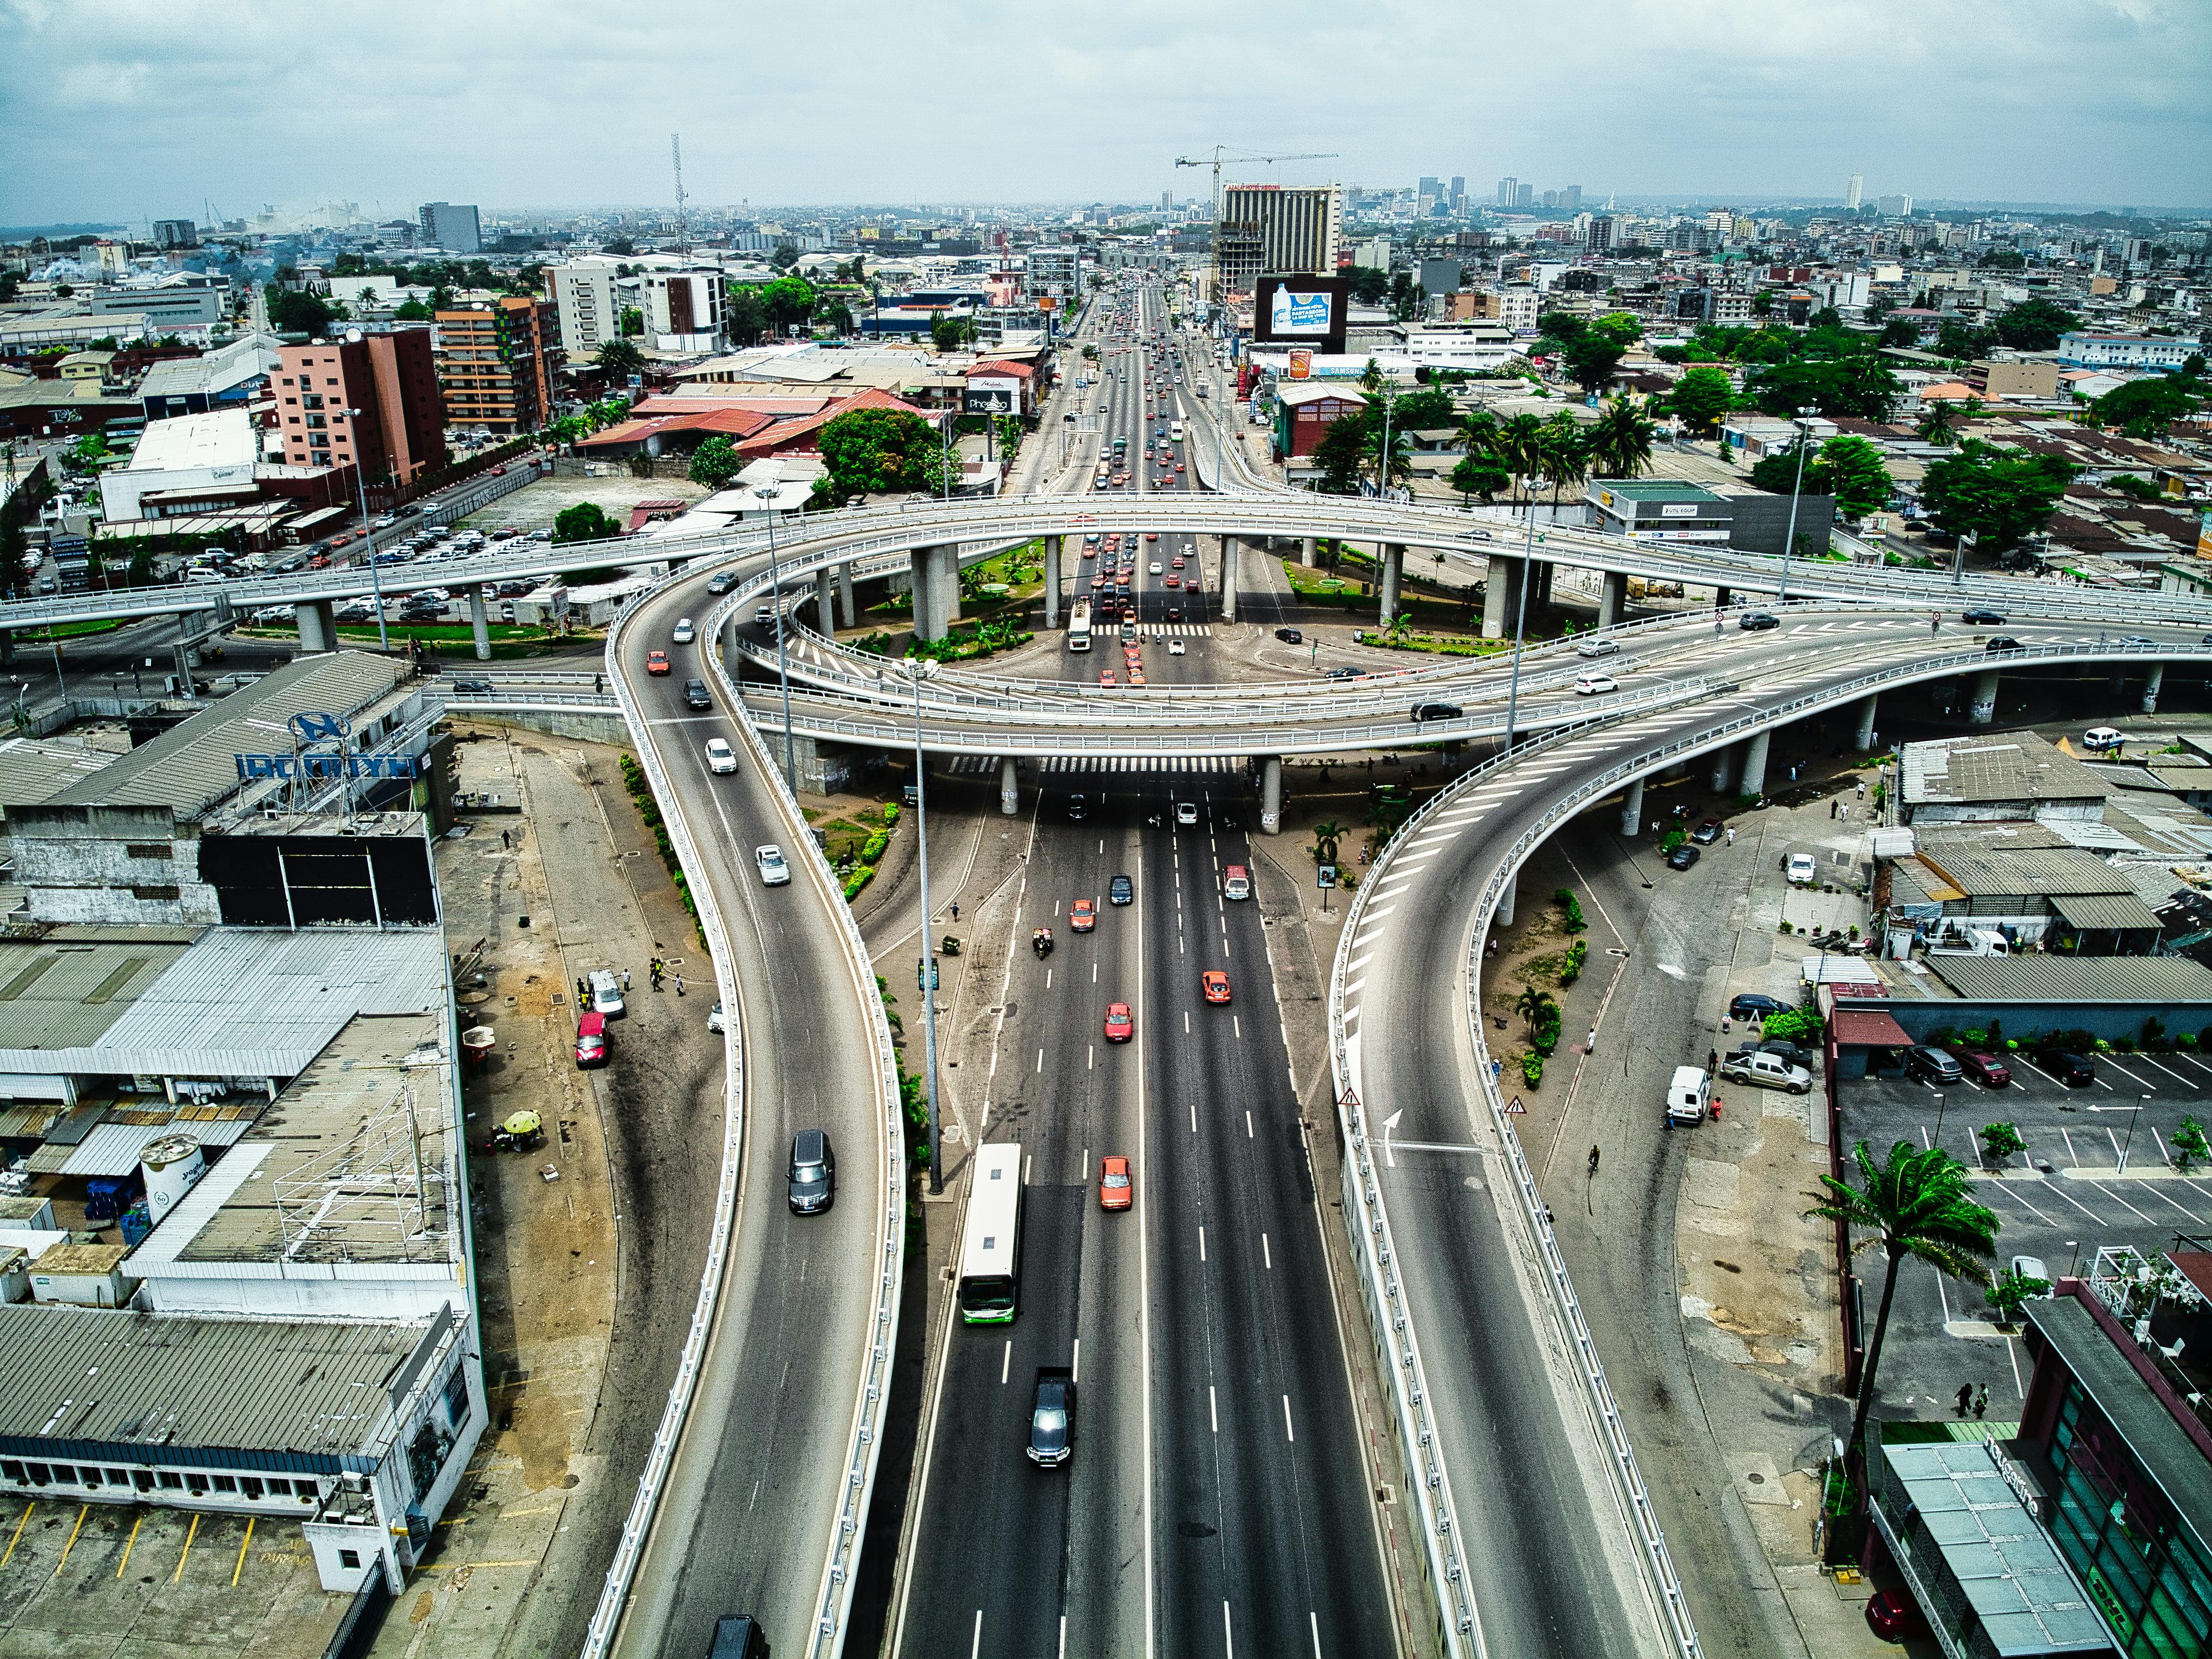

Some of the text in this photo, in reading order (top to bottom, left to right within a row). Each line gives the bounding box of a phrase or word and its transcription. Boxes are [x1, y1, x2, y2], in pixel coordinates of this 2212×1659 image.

[1984, 1432, 2038, 1516] nougatine
[1885, 1530, 1921, 1595] BOULANGERIE
[2092, 1577, 2127, 1635] DHL
